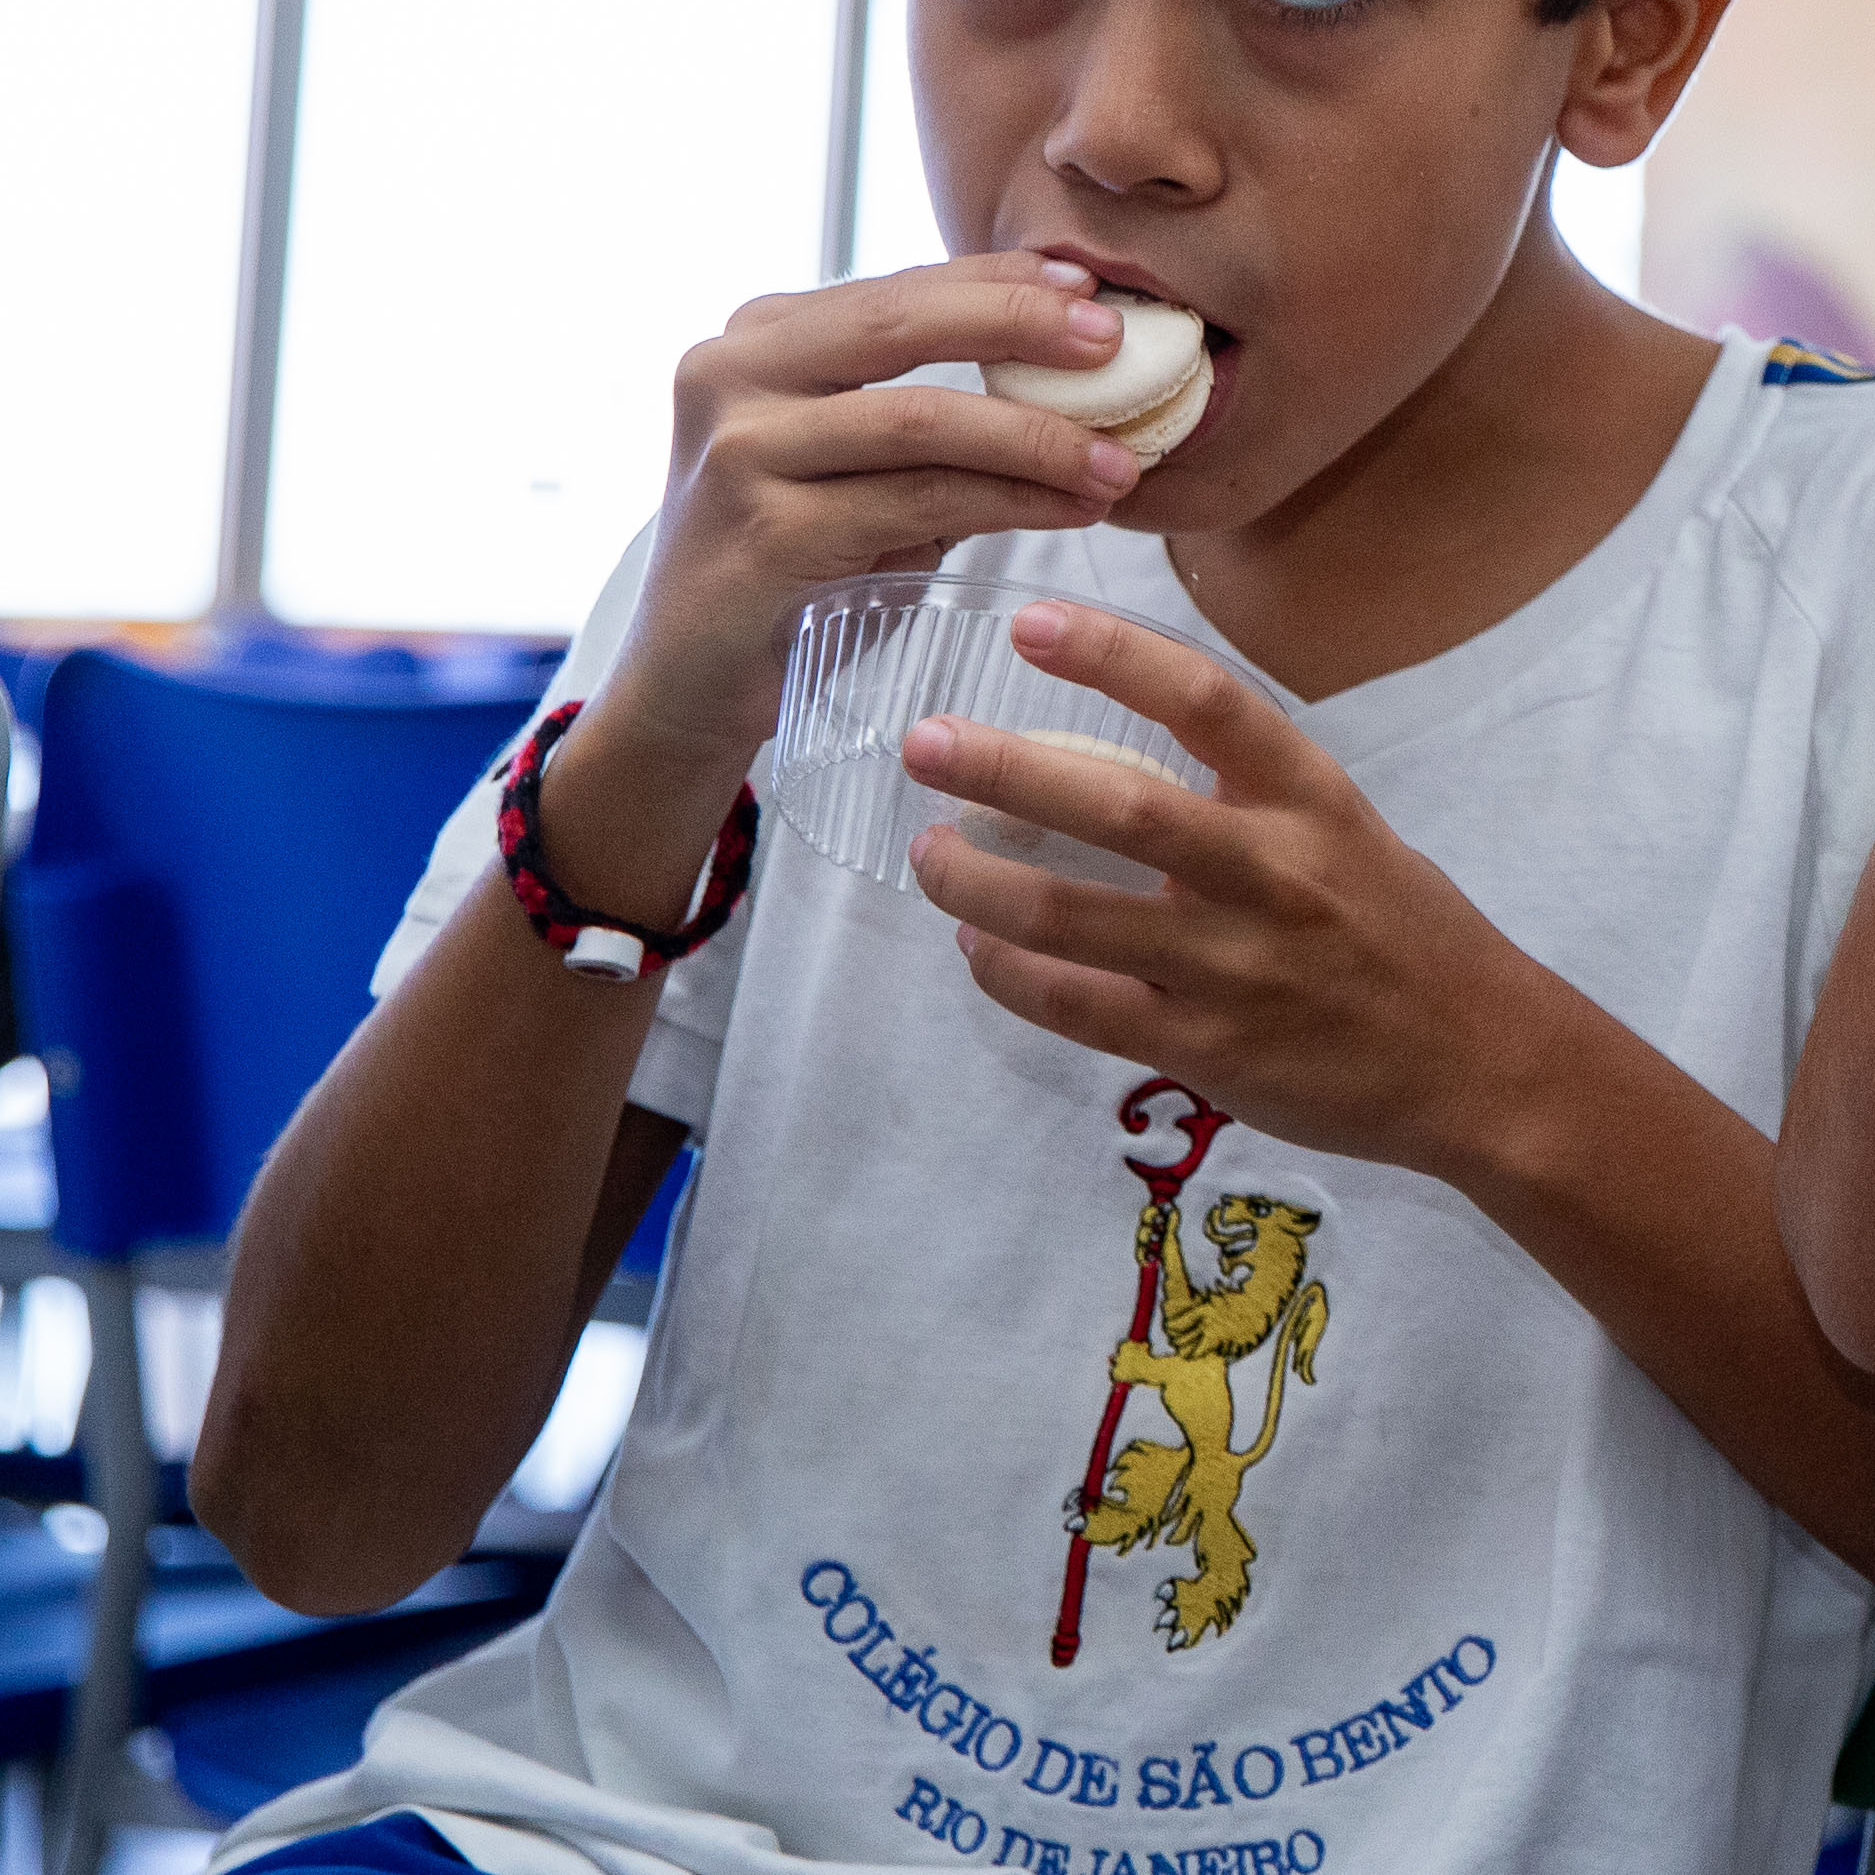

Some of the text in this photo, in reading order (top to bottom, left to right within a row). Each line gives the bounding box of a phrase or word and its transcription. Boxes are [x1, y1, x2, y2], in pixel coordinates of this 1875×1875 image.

[801, 1558, 1498, 1810] COLÉGIO DE SÃO BENTO
[895, 1775, 990, 1856] RIO
